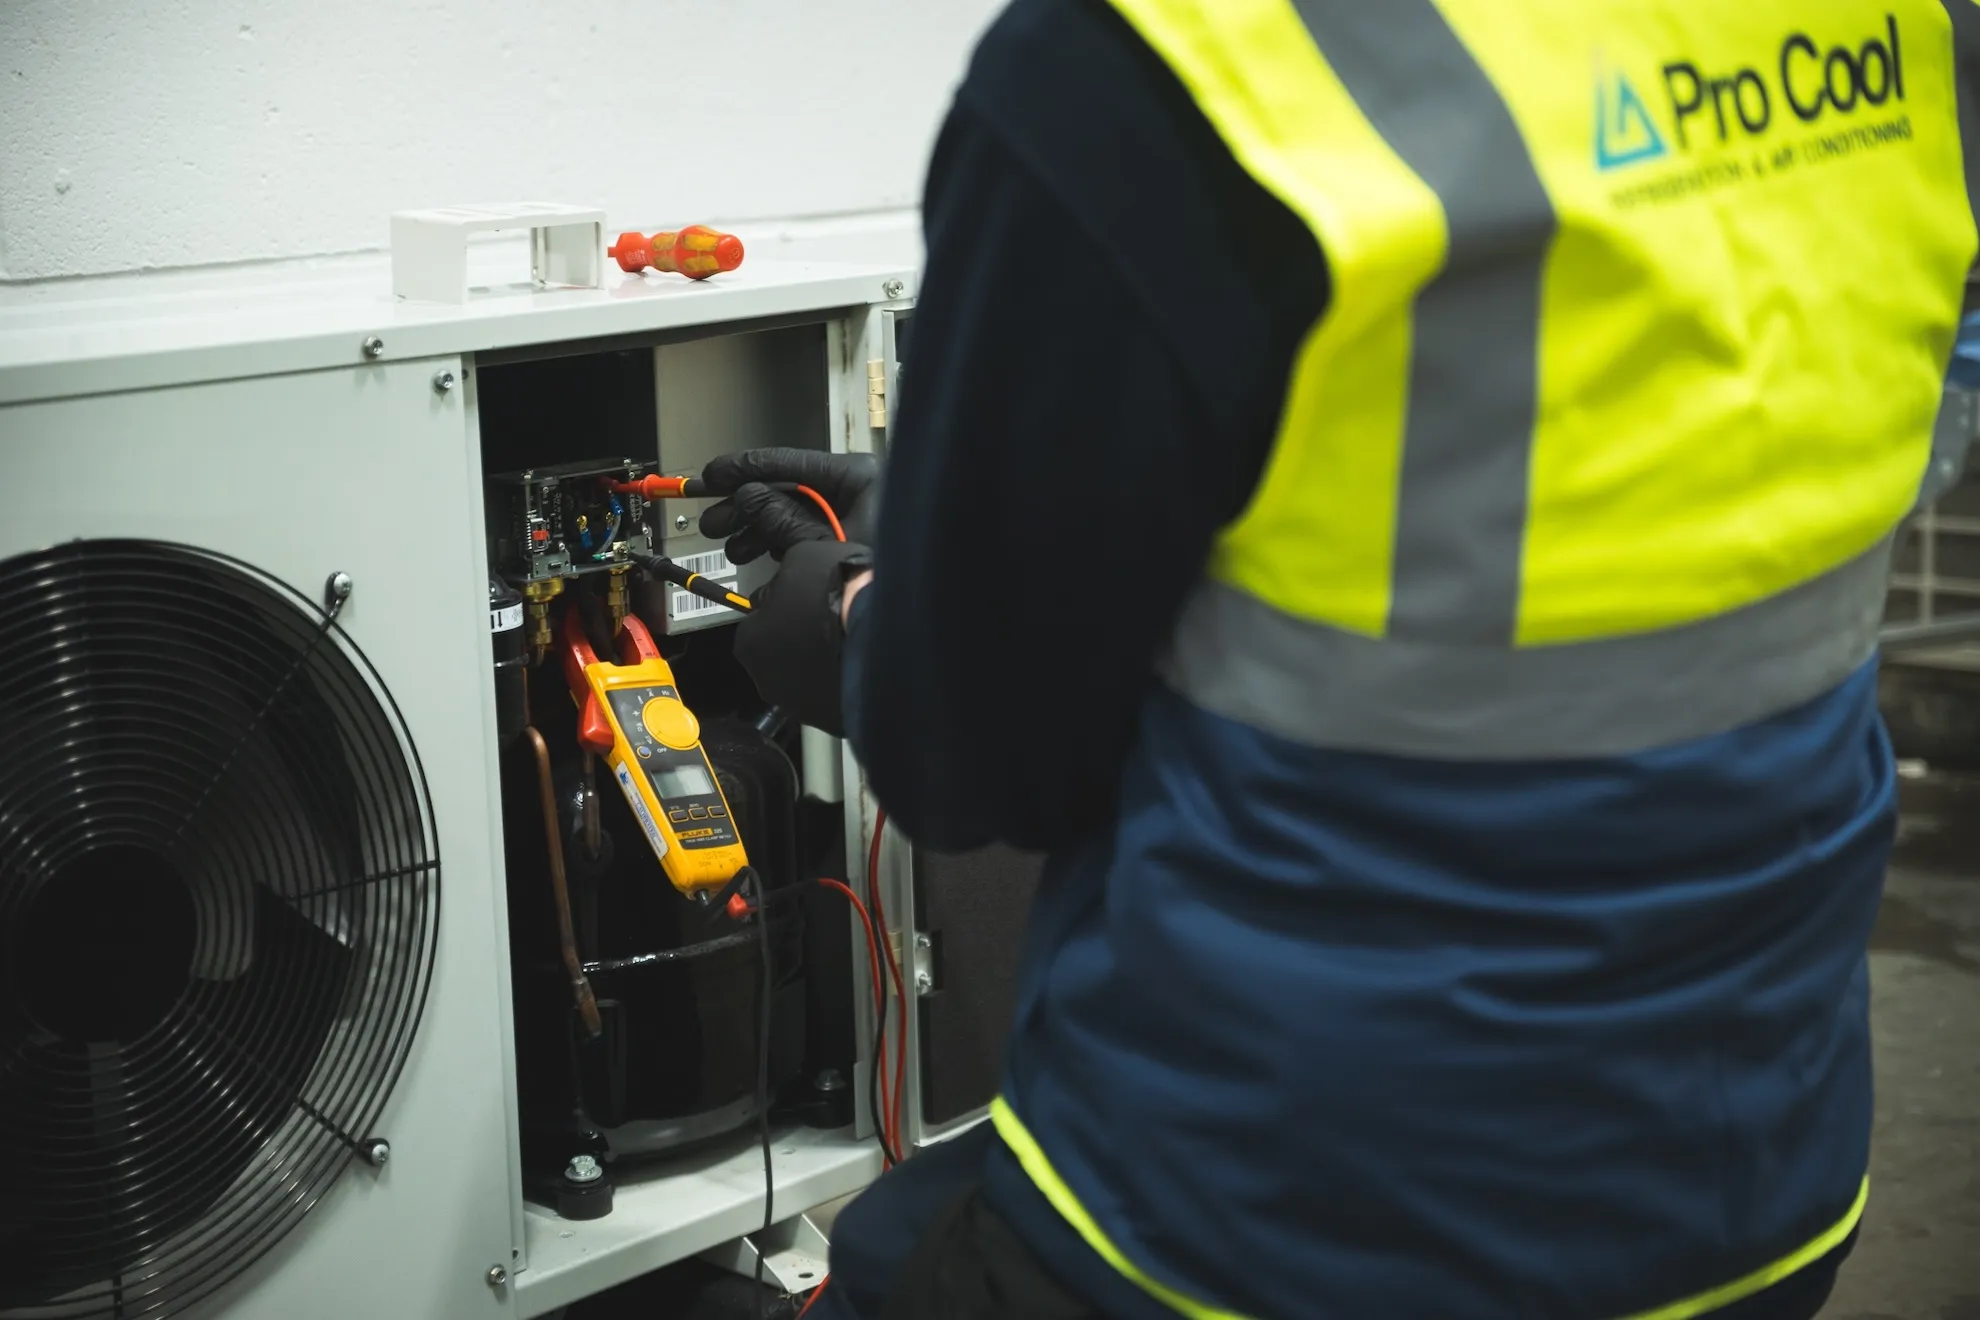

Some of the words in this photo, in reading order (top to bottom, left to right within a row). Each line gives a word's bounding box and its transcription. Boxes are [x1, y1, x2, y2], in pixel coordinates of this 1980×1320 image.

[1663, 62, 1770, 149] Pro
[1779, 13, 1904, 122] Cool
[1803, 117, 1914, 165] CONDITIONING
[681, 829, 710, 838] FLUKE
